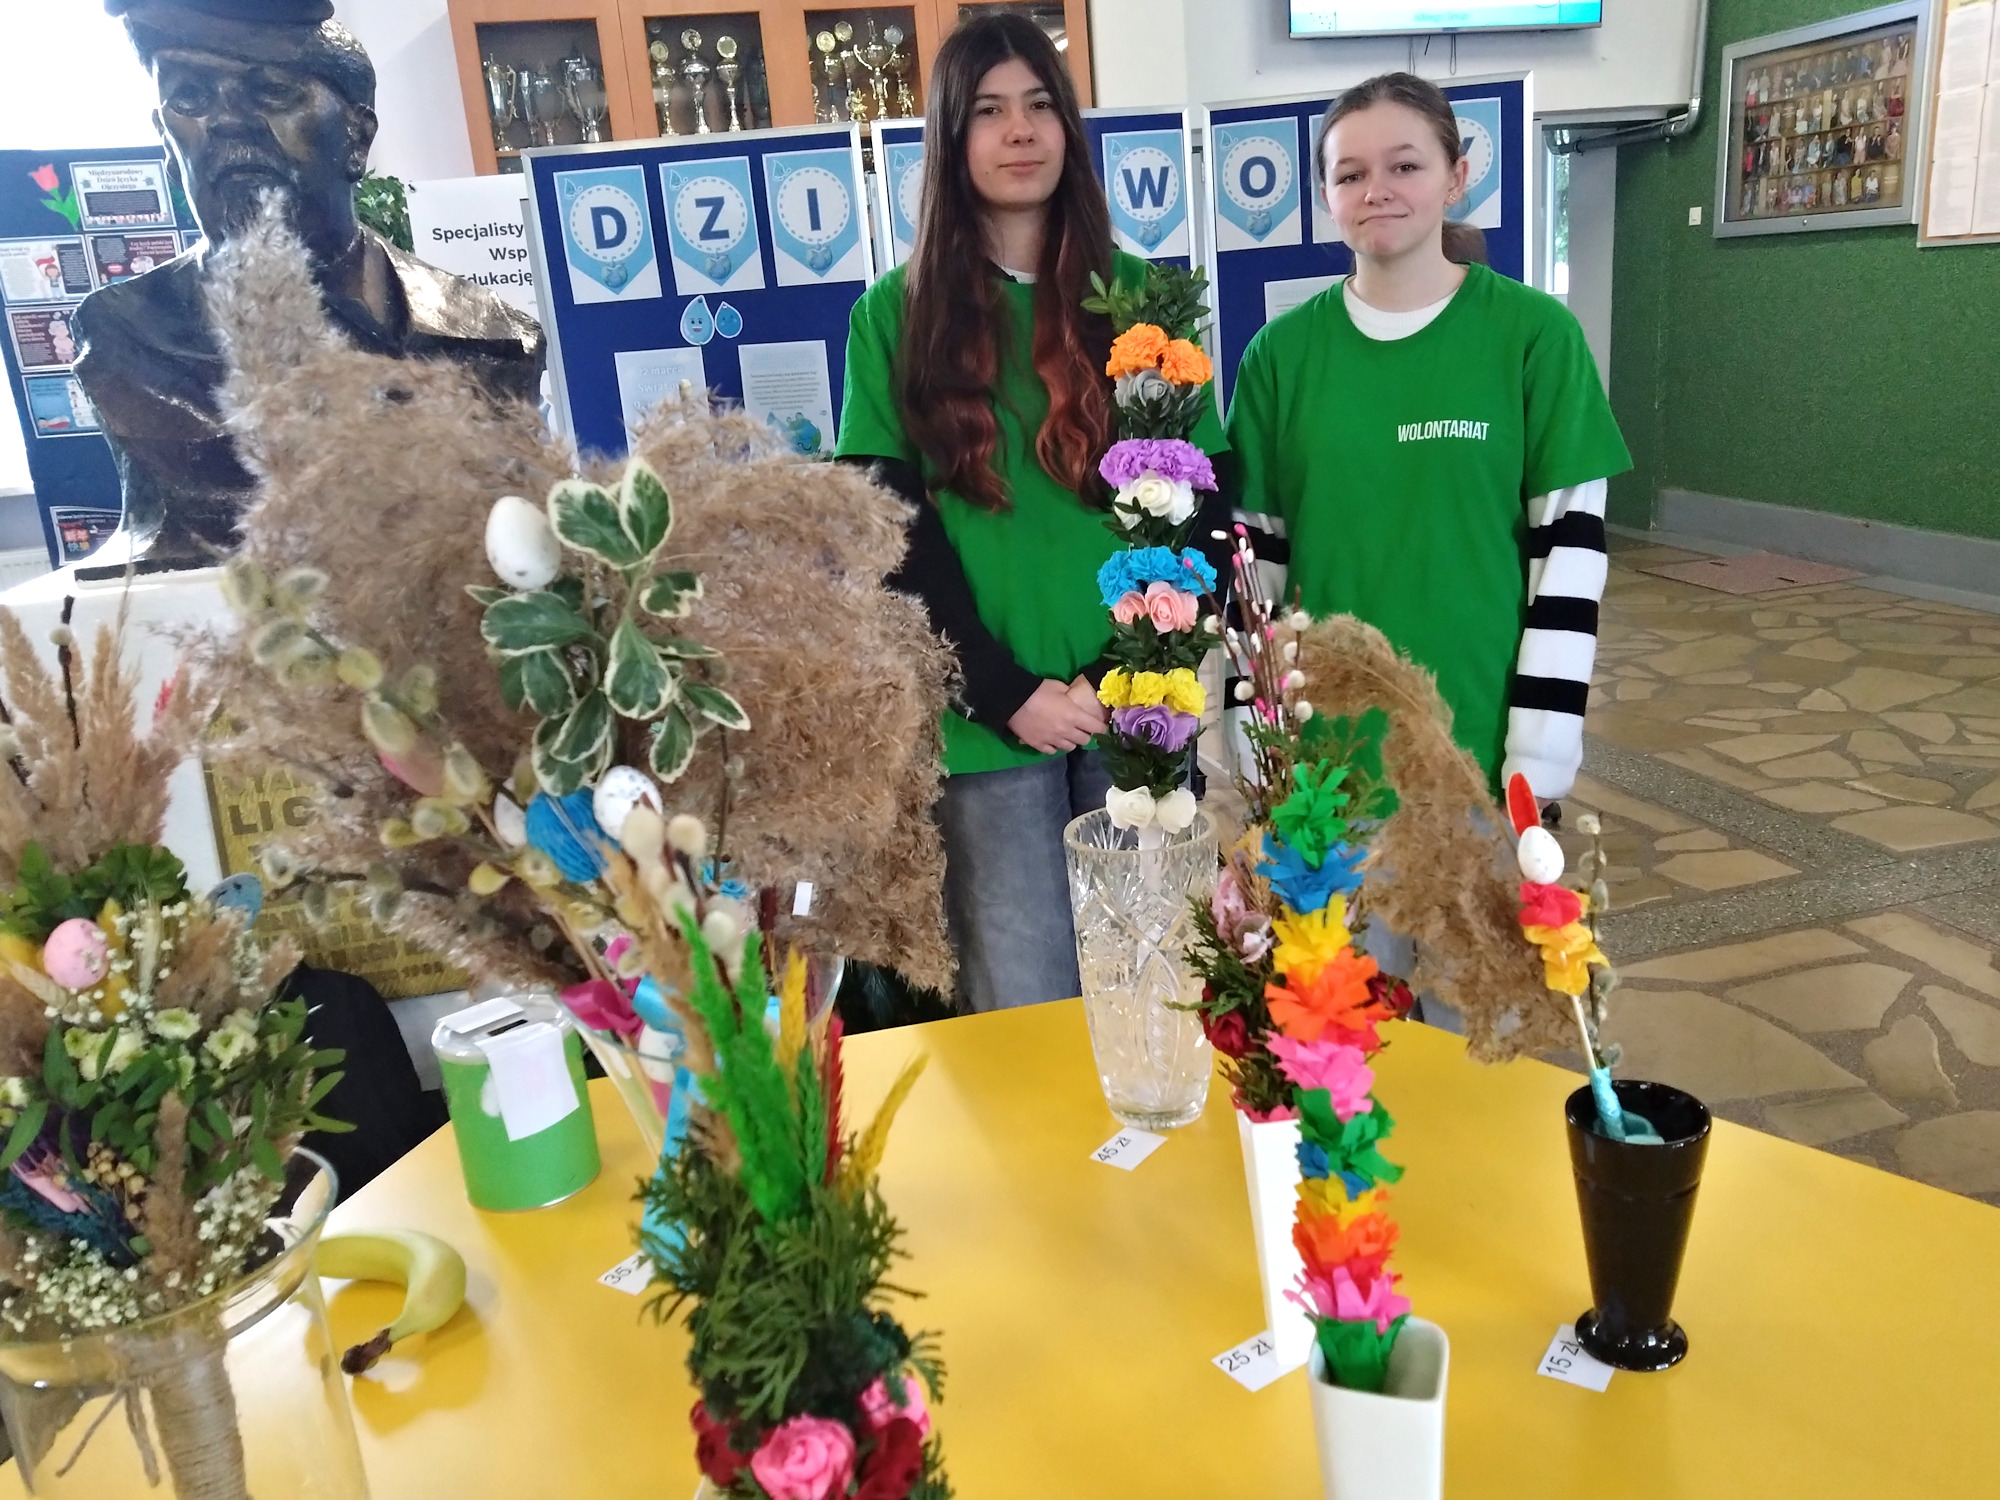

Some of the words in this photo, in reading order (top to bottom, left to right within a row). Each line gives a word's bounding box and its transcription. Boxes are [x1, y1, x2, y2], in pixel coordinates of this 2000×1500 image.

[1121, 166, 1170, 210] W
[1239, 156, 1277, 199] O
[590, 206, 628, 250] D
[695, 196, 730, 241] Z
[807, 188, 822, 231] I
[457, 269, 533, 287] dukację
[1397, 420, 1489, 442] WOLONTARIAT
[1097, 1146, 1119, 1161] 45
[1115, 1136, 1132, 1148] zł
[604, 1266, 632, 1285] 35
[1219, 1350, 1251, 1372] 25
[1251, 1339, 1273, 1356] zł
[1546, 1356, 1572, 1375] 15
[1560, 1340, 1581, 1357] zł
